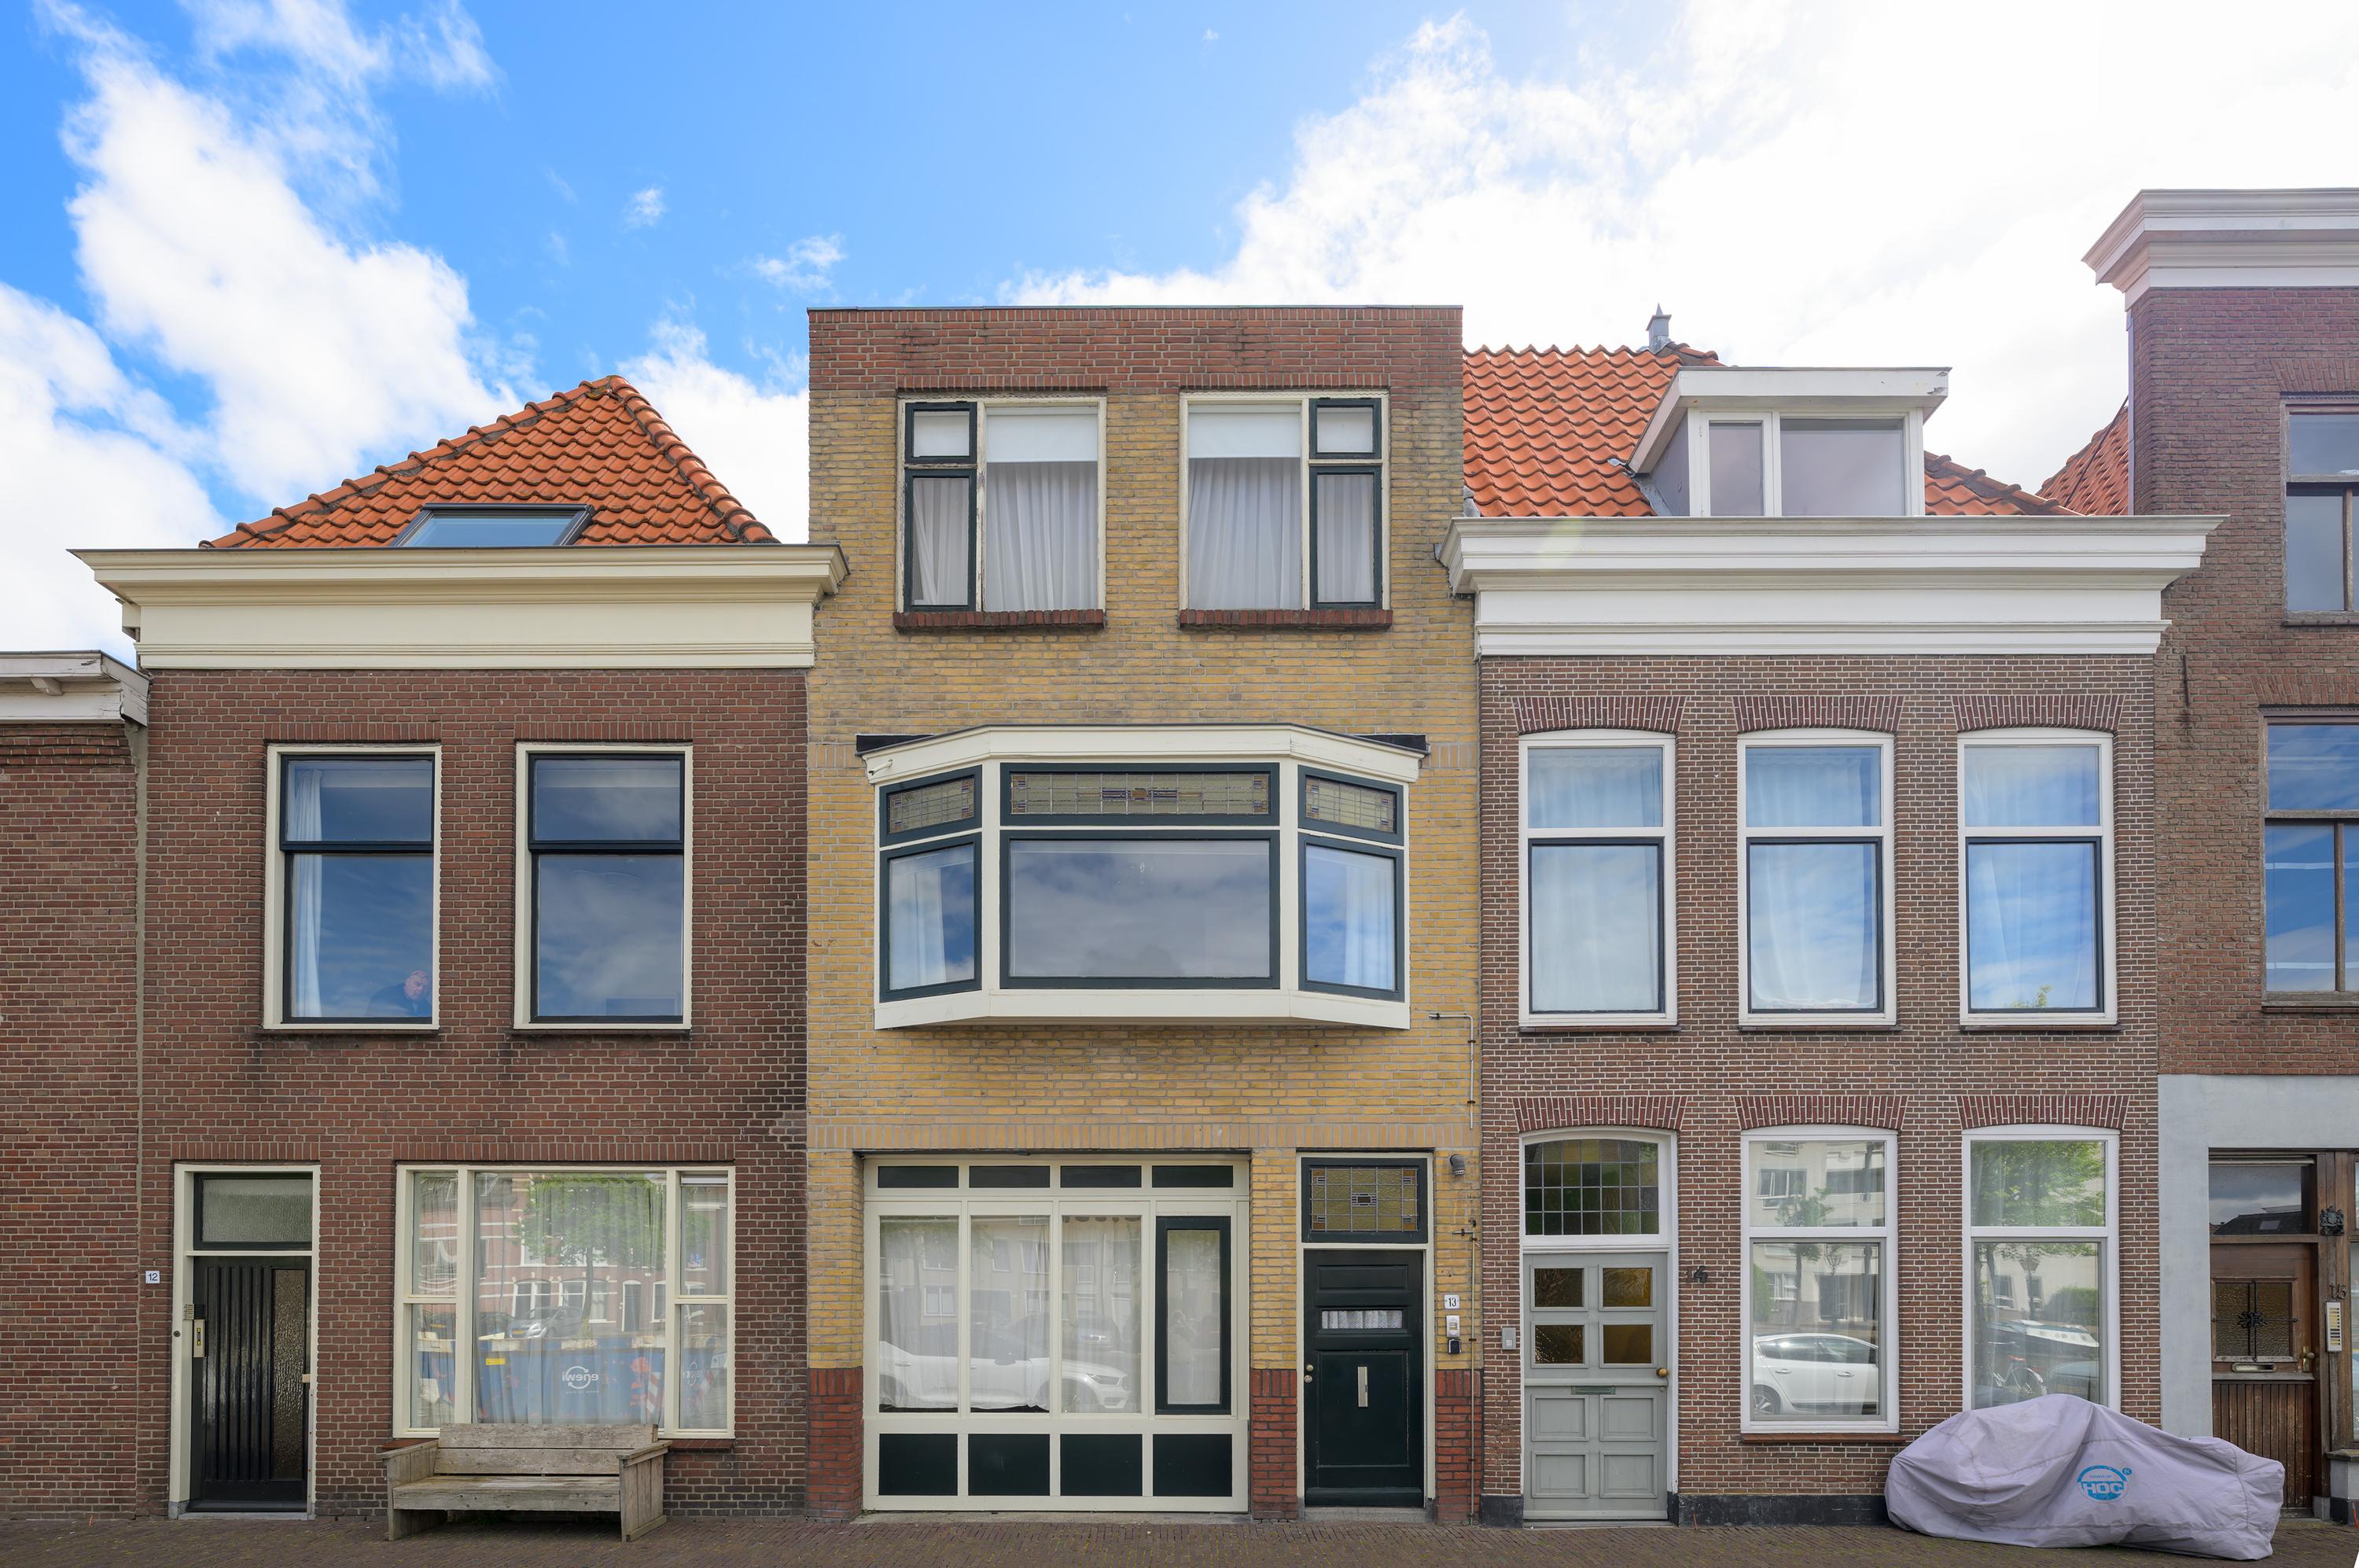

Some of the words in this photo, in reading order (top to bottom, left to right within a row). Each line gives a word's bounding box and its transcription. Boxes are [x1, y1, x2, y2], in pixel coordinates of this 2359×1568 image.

[148, 1272, 158, 1282] 12
[1686, 1265, 1708, 1283] 14
[2329, 1283, 2346, 1300] 15
[1448, 1297, 1457, 1307] 13
